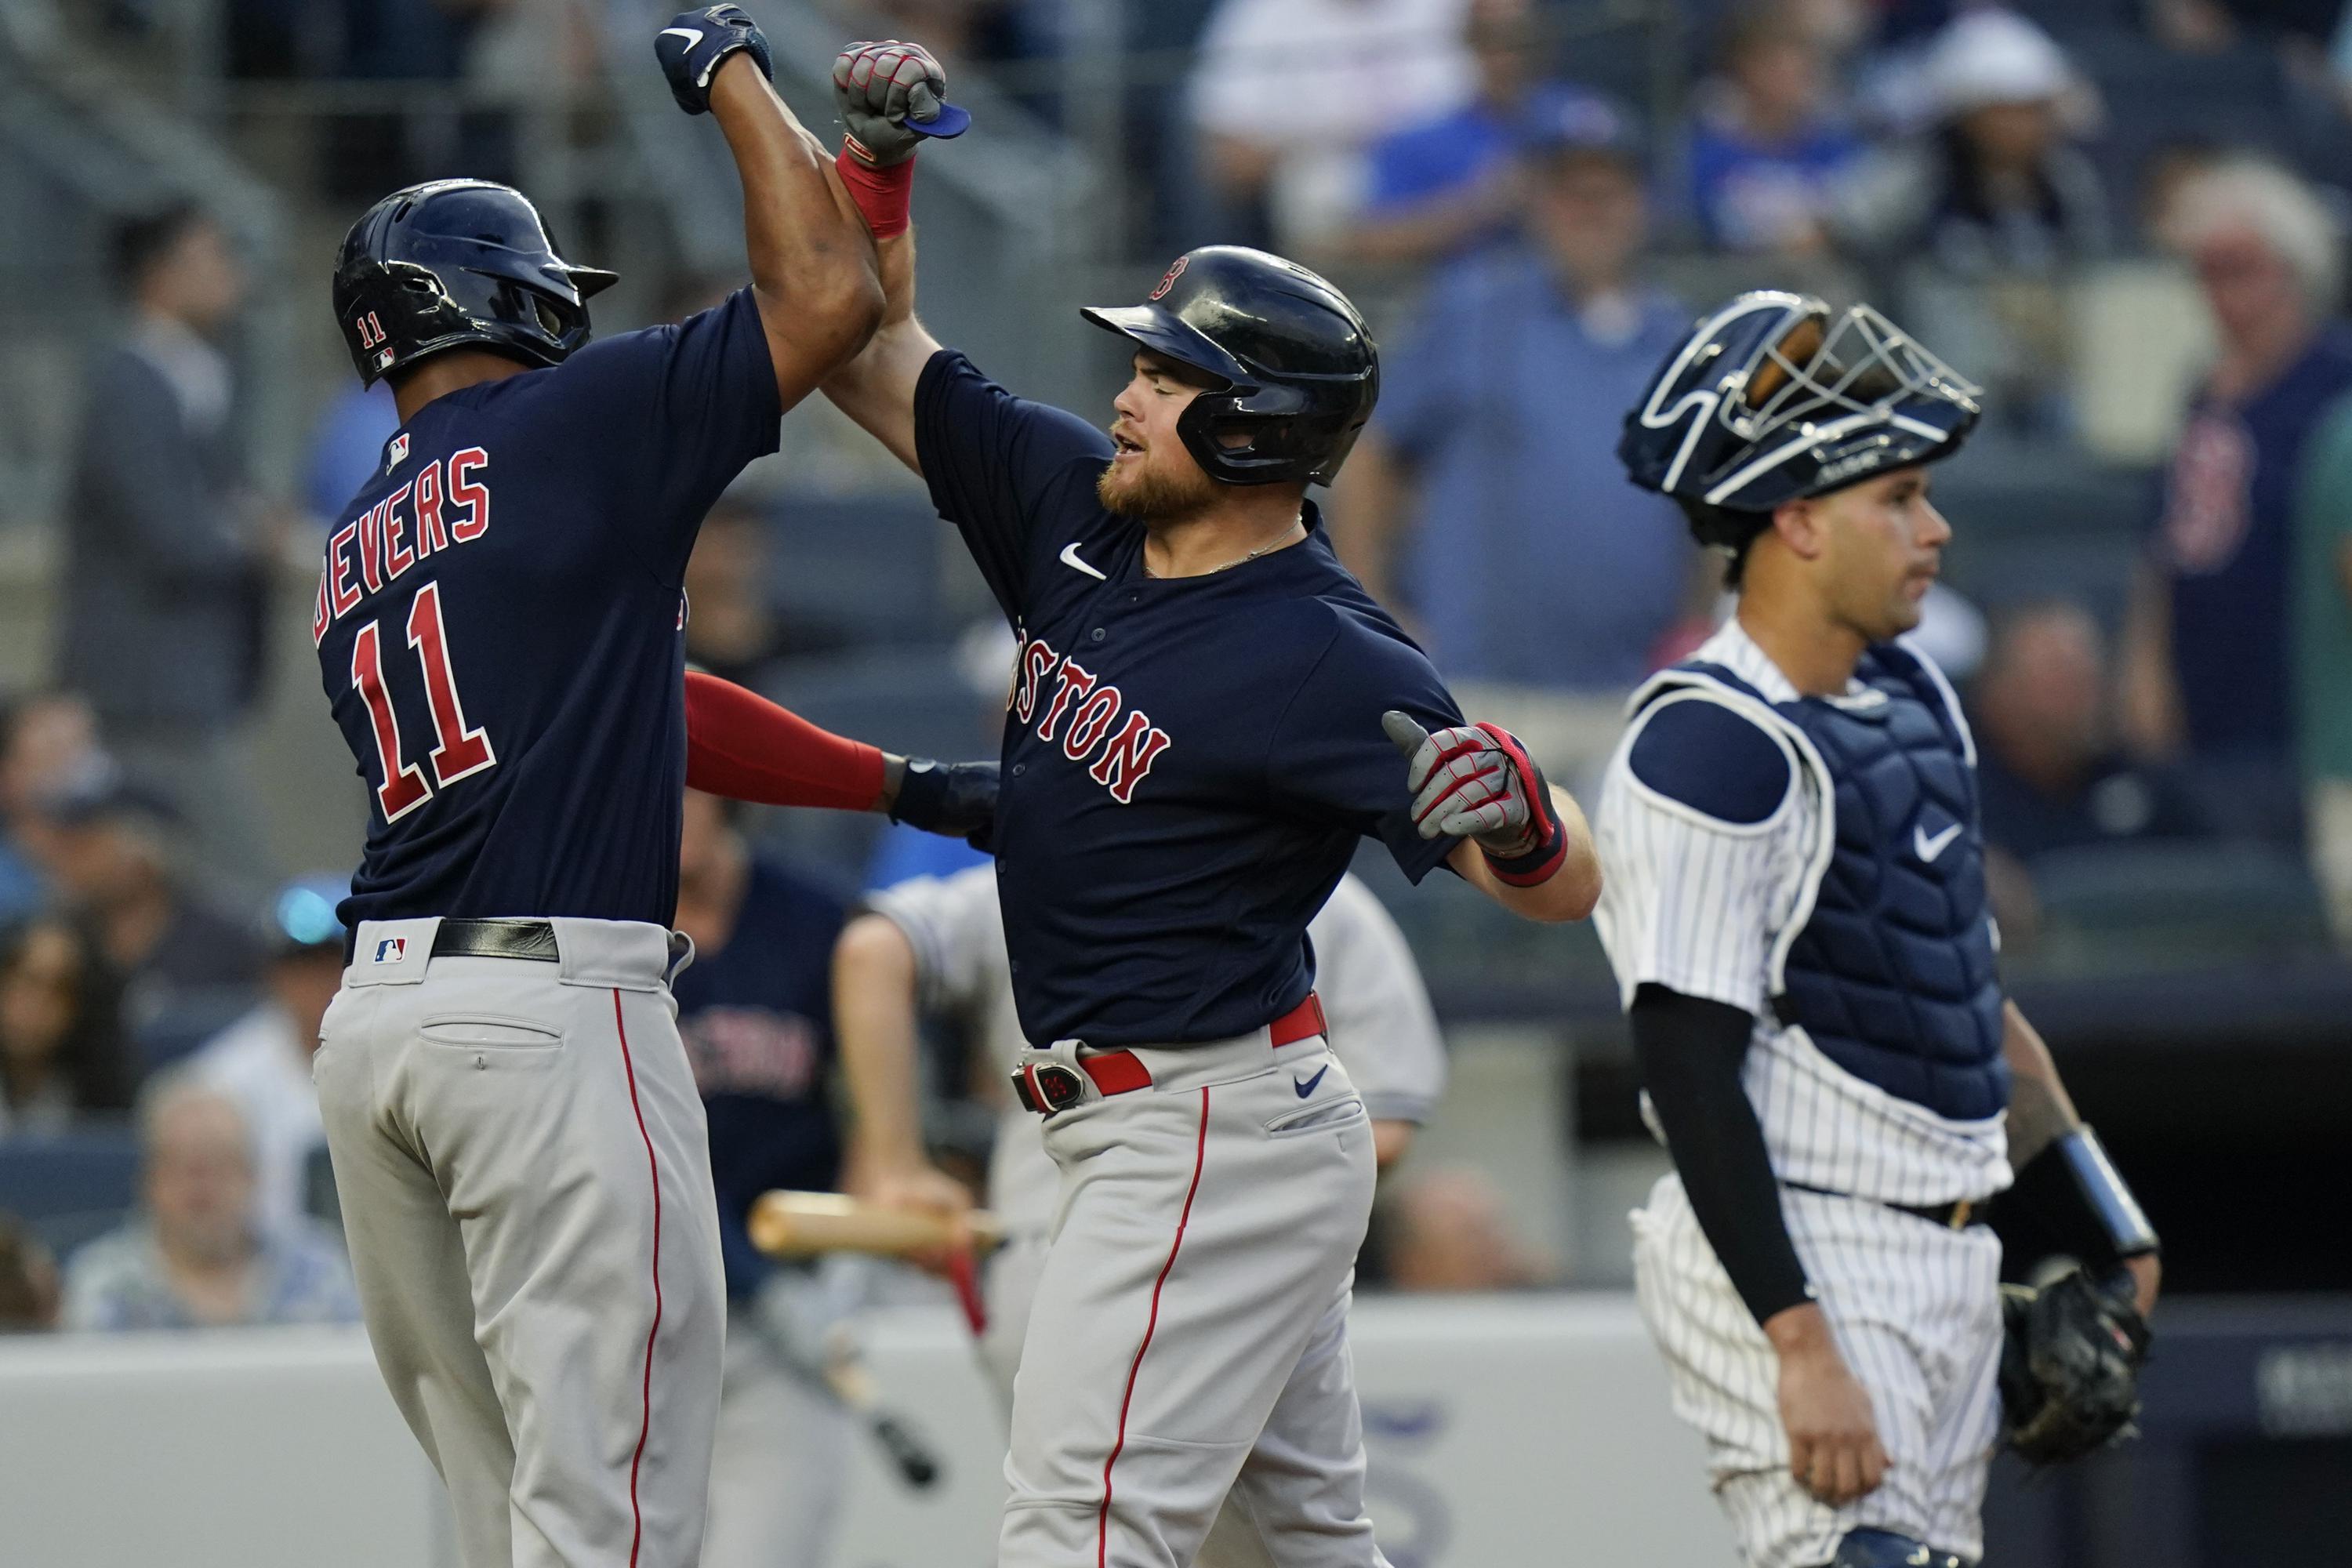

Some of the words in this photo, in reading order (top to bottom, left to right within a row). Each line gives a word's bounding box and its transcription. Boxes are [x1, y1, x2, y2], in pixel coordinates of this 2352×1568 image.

[357, 310, 387, 350] 11
[1149, 256, 1190, 301] B
[351, 579, 497, 825] 11
[1007, 615, 1171, 804] STON
